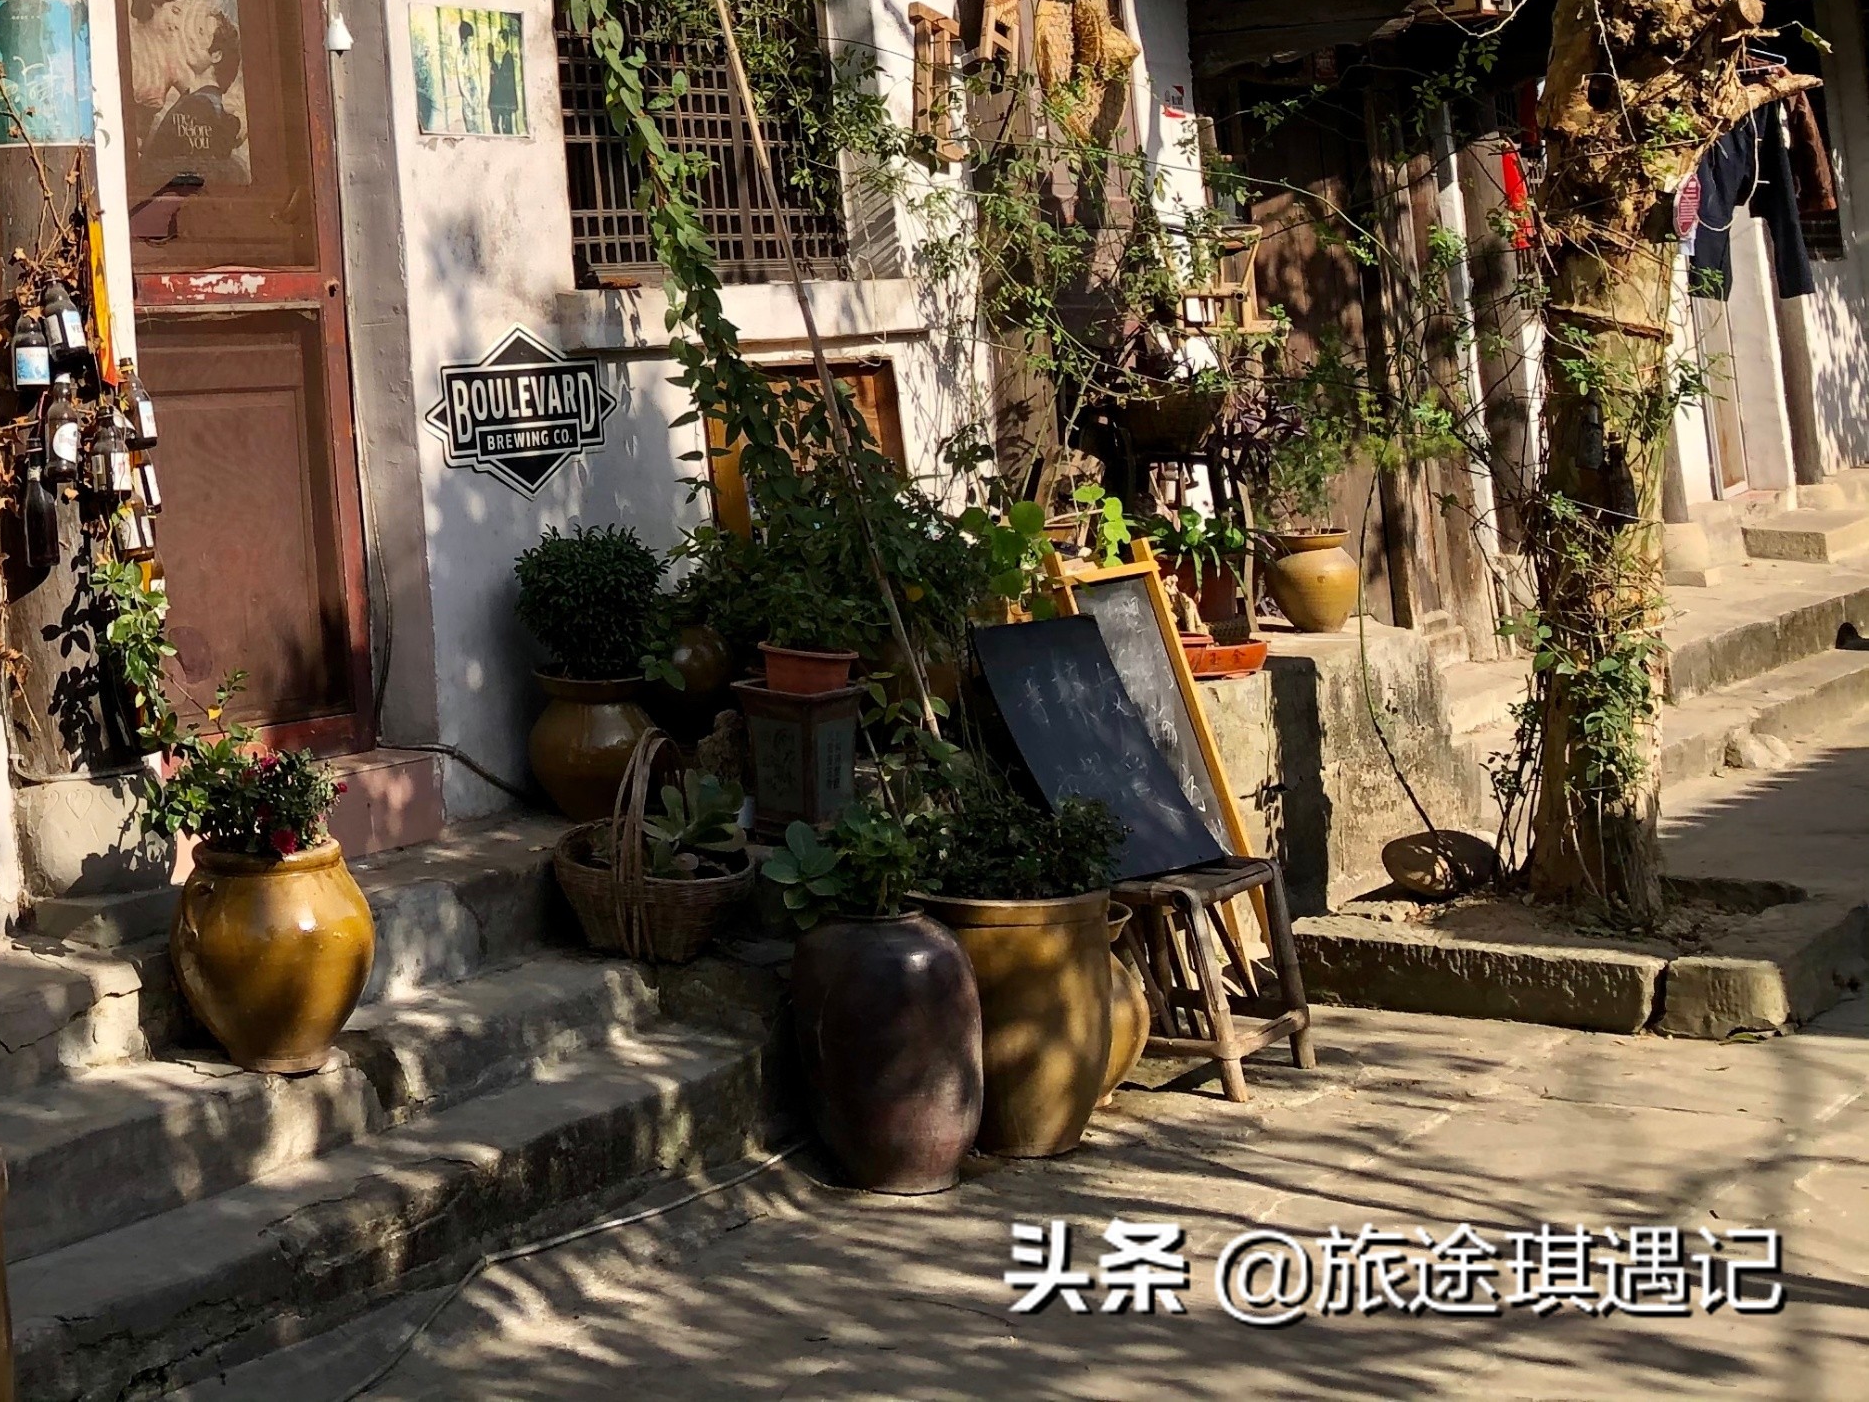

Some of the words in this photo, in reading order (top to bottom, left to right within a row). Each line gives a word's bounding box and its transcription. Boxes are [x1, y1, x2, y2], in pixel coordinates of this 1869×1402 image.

[451, 371, 595, 443] BOULEVARD
[486, 429, 550, 450] BREWING
[553, 428, 574, 445] CO.
